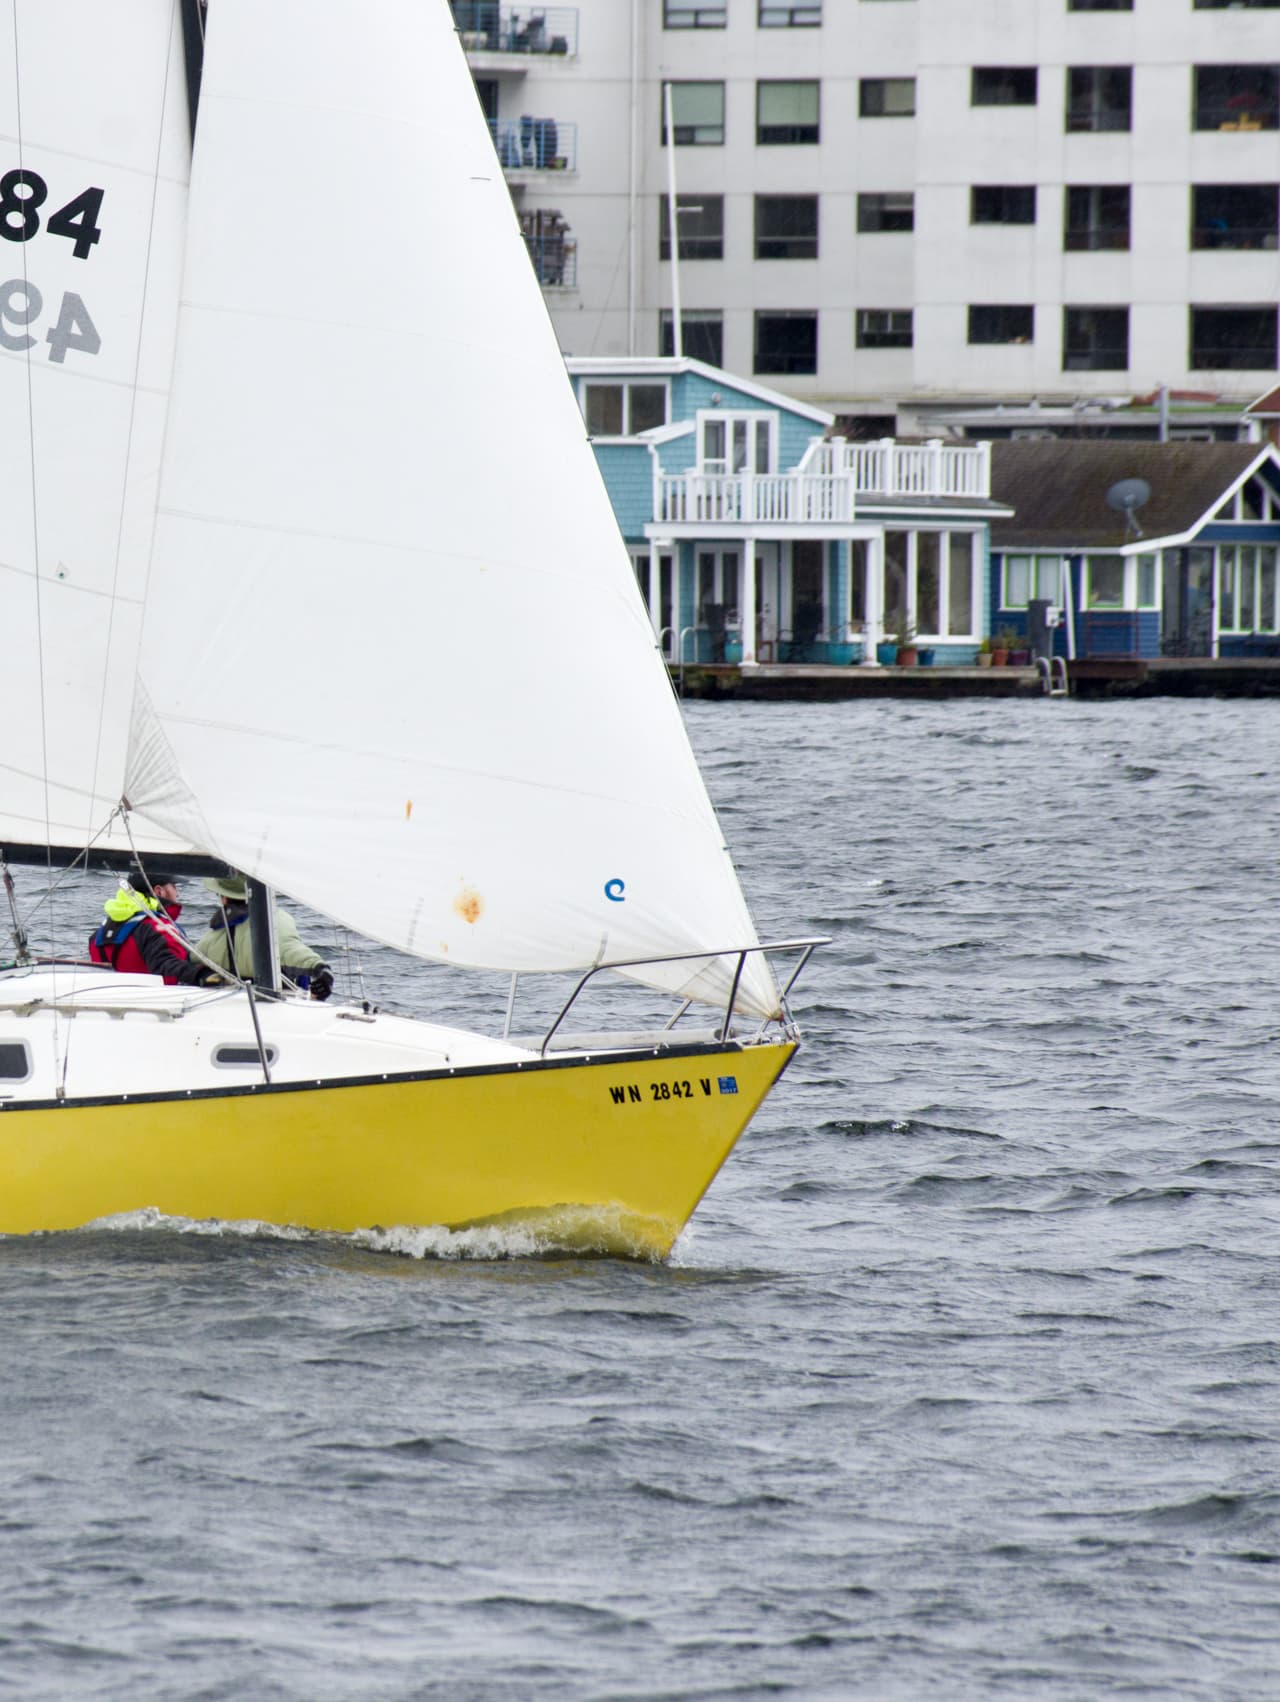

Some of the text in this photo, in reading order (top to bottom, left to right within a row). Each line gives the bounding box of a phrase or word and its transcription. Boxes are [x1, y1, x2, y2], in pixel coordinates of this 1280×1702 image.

[609, 1085, 642, 1104] WN
[650, 1080, 694, 1101] 2842
[699, 1078, 712, 1096] V
